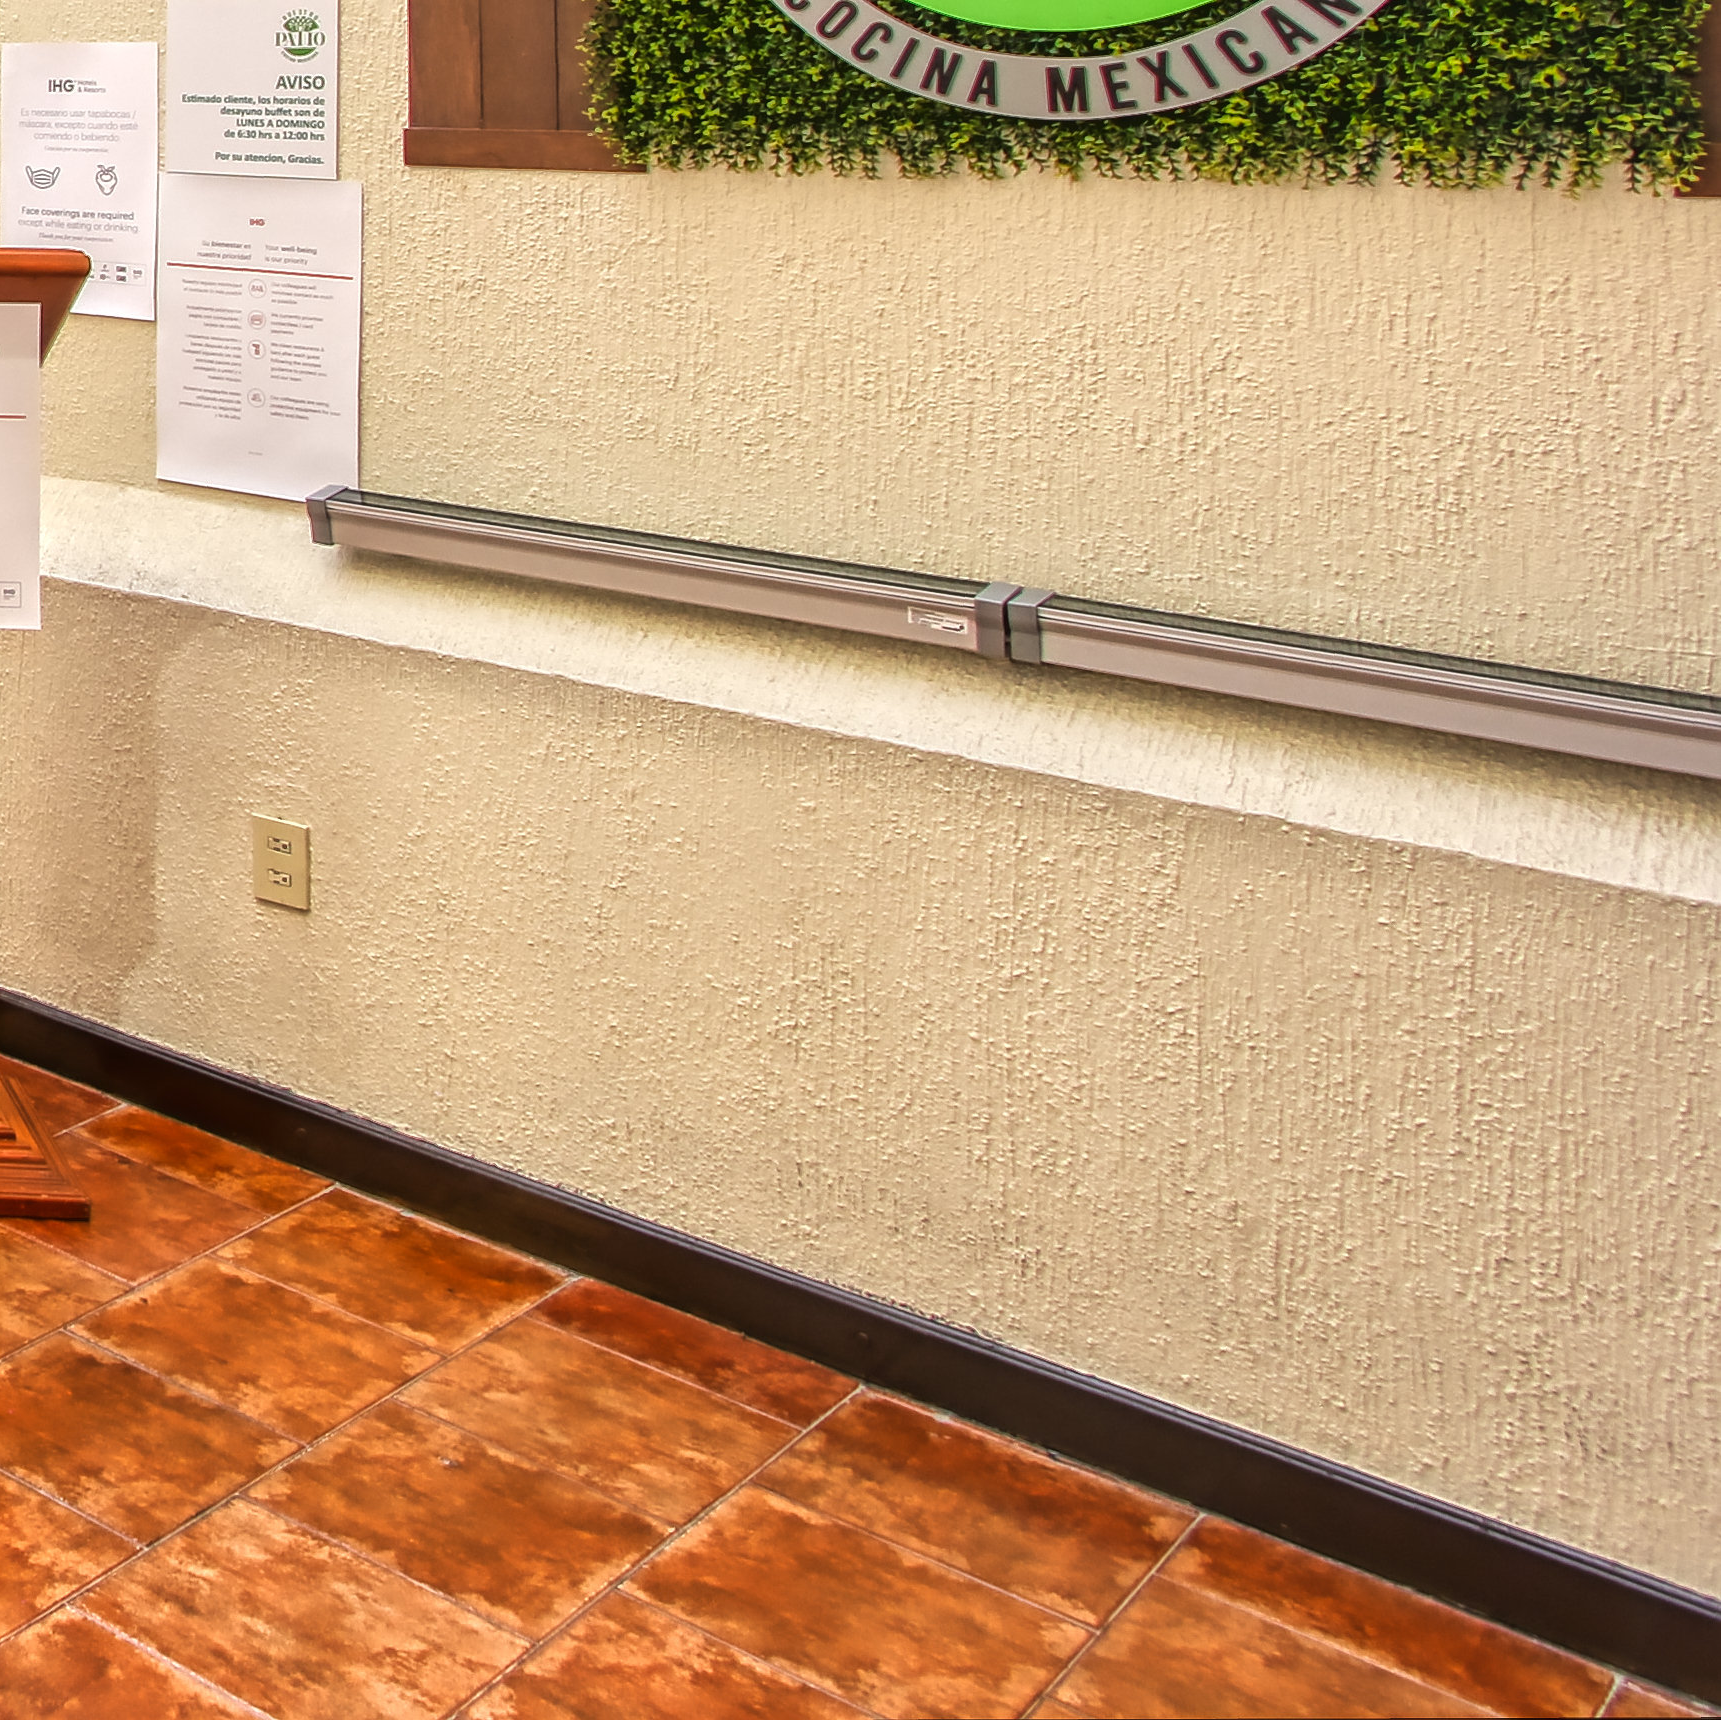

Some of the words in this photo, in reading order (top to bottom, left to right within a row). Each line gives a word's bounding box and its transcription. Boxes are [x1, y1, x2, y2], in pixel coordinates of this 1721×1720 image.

[275, 32, 326, 47] PATIO
[48, 80, 74, 93] IHG
[276, 75, 325, 90] AVISO
[182, 94, 222, 104] Estimado
[224, 96, 256, 105] cliente,
[258, 96, 271, 104] los
[273, 97, 311, 105] horarios
[313, 97, 325, 106] de
[21, 108, 29, 116] Es
[31, 109, 68, 117] necesario
[88, 110, 130, 119] tapabocas
[220, 107, 262, 117] desayuno
[265, 108, 292, 116] buffet
[313, 109, 325, 117] de
[55, 122, 85, 131] excepto
[88, 121, 117, 130] cuando
[236, 119, 265, 127] LUNES
[267, 120, 274, 128] A
[276, 120, 325, 129] DOMINGO
[34, 132, 72, 141] comiendo
[224, 130, 235, 138] de
[238, 130, 256, 138] 6:30
[258, 131, 272, 139] hrs
[283, 131, 308, 140] 12:00
[310, 132, 325, 141] hrs
[215, 152, 230, 160] Por
[288, 155, 324, 165] Gracias.
[21, 207, 39, 215] Face
[41, 208, 80, 219] coverings
[97, 211, 134, 221] required
[18, 219, 42, 227] except
[45, 220, 65, 228] while
[67, 221, 91, 231] eating
